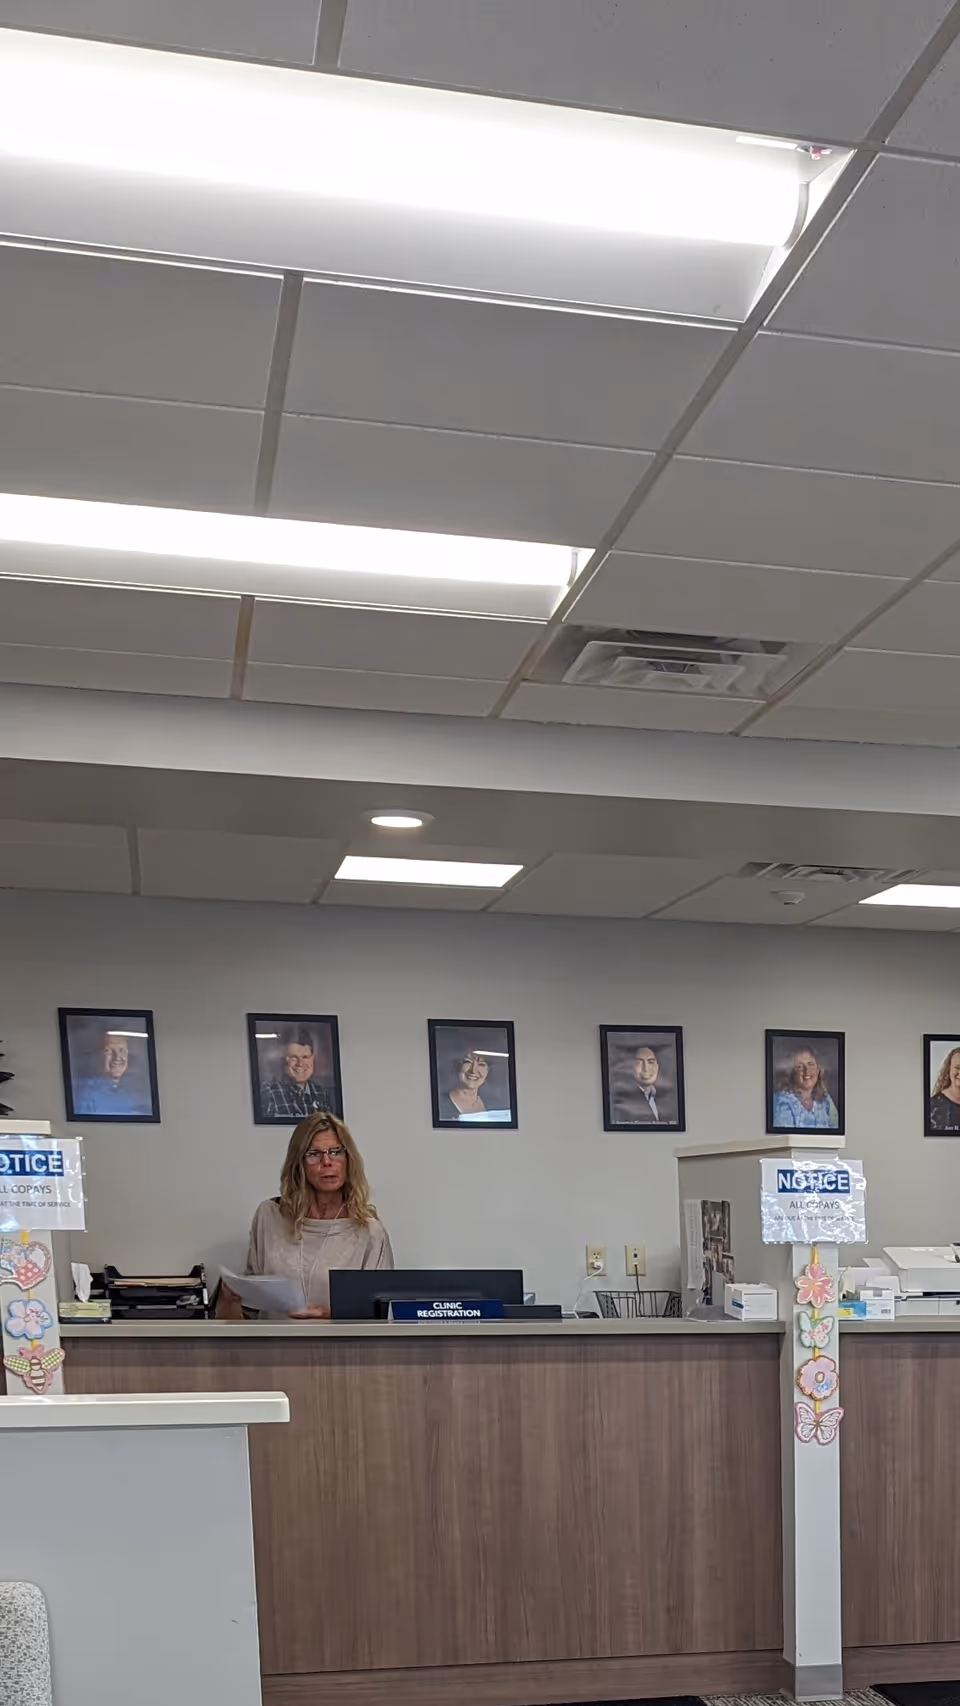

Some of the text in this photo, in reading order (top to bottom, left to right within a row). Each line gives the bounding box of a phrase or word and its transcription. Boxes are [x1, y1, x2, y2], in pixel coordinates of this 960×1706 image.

[0, 1153, 63, 1173] OTICE
[778, 1172, 849, 1190] NOTICE
[0, 1184, 52, 1194] LL COPAYS
[789, 1201, 804, 1209] ALL
[416, 1309, 481, 1317] REGISTRATION
